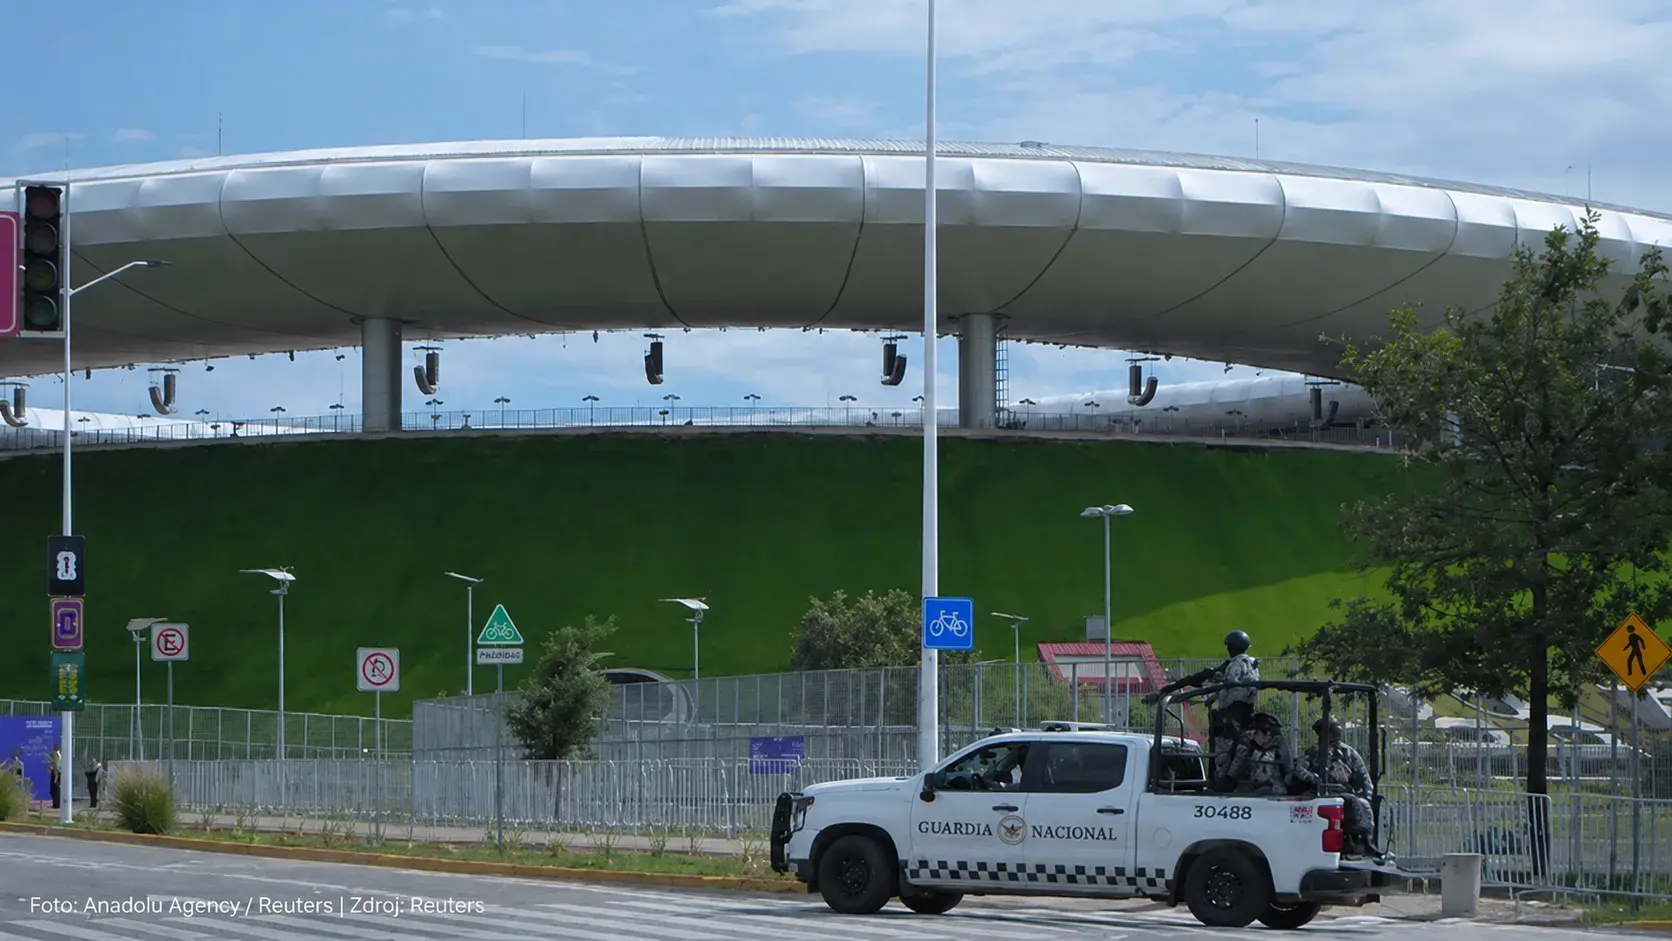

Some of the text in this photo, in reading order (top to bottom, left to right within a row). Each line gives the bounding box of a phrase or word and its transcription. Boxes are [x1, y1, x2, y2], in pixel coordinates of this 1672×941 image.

[164, 633, 177, 651] E
[1194, 804, 1252, 820] 30488
[918, 820, 1118, 841] GUARDIA NACIONAL
